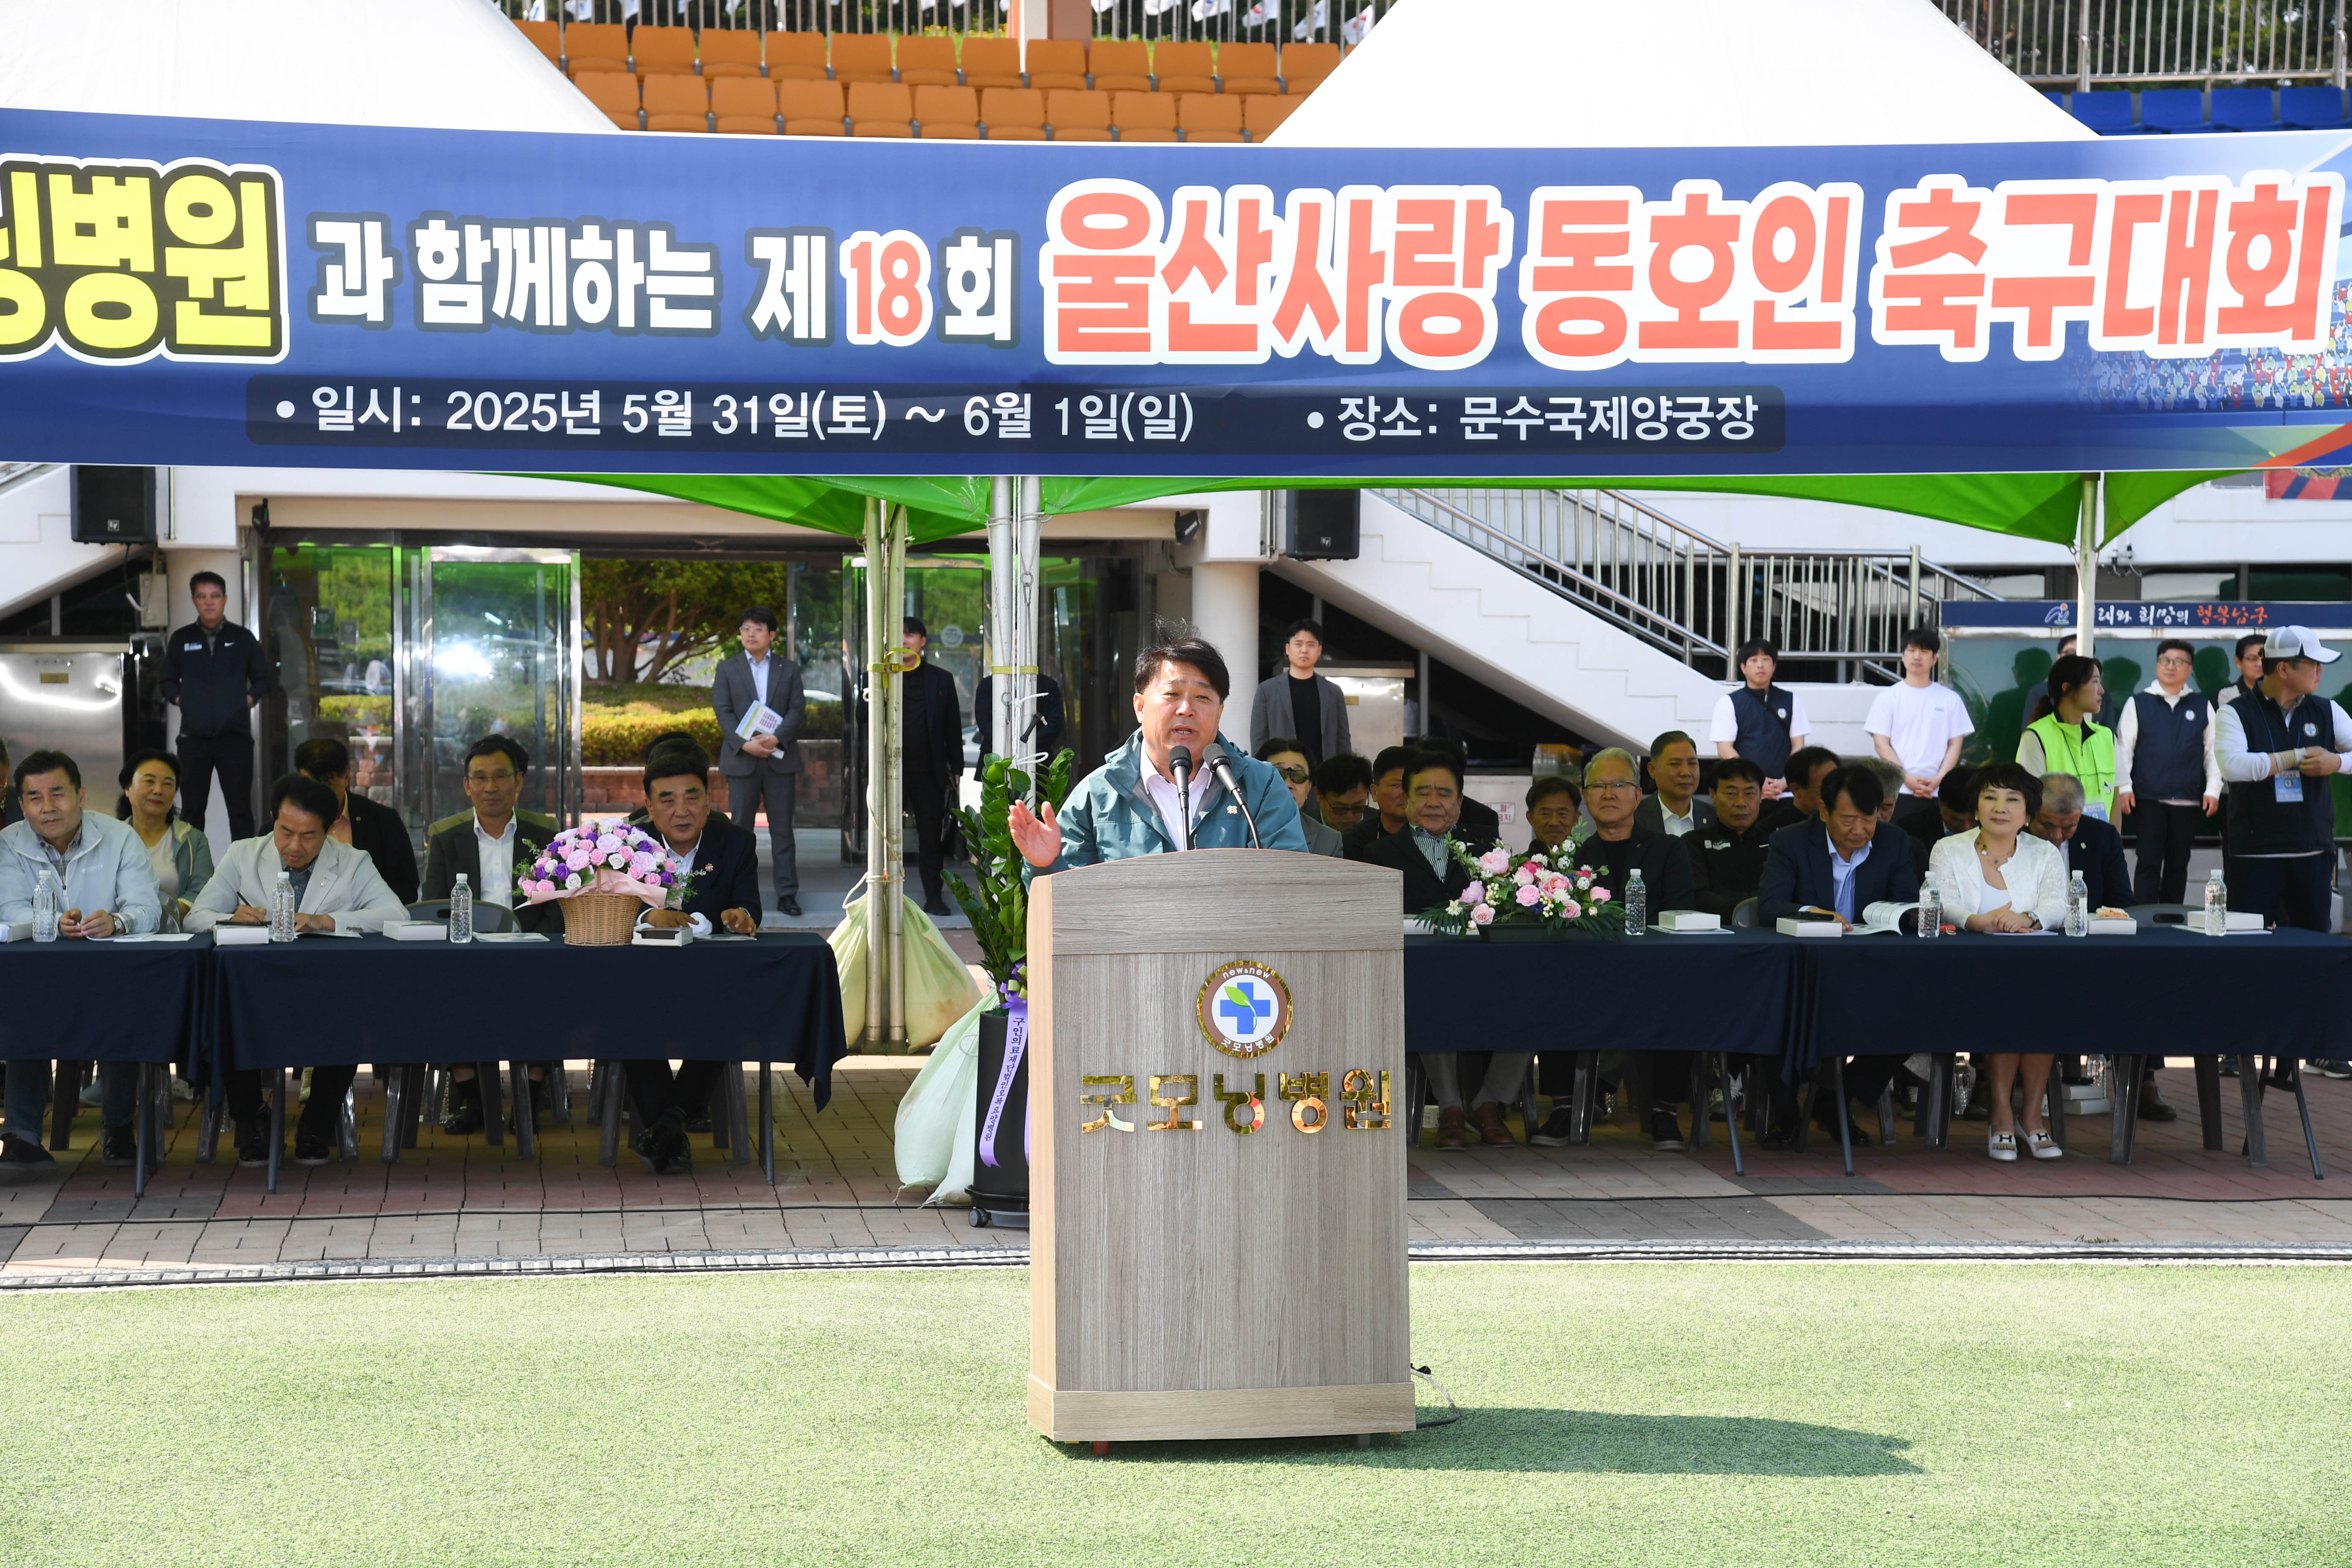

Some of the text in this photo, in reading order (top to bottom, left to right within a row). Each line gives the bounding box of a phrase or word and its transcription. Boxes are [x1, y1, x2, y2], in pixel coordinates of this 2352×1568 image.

[415, 219, 715, 329] 함께하는
[1052, 191, 1501, 358] 울산사랑
[1531, 192, 1851, 358] 동호인
[1881, 183, 2332, 349] 축구대회
[312, 386, 421, 433] 일시:
[446, 389, 601, 435] 2025년
[622, 389, 692, 437] 5월
[712, 390, 886, 441] 31일(토)
[964, 392, 1032, 438] 6월
[1055, 392, 1193, 442] 1일(일)
[1337, 395, 1759, 441] 장소: 문수국제양궁장
[2097, 604, 2269, 626] 래와 희망의 행복남구
[1222, 967, 1271, 980] new&new
[1220, 1033, 1275, 1053] 굿모닝병원
[1080, 1068, 1392, 1135] 굿모닝병원
